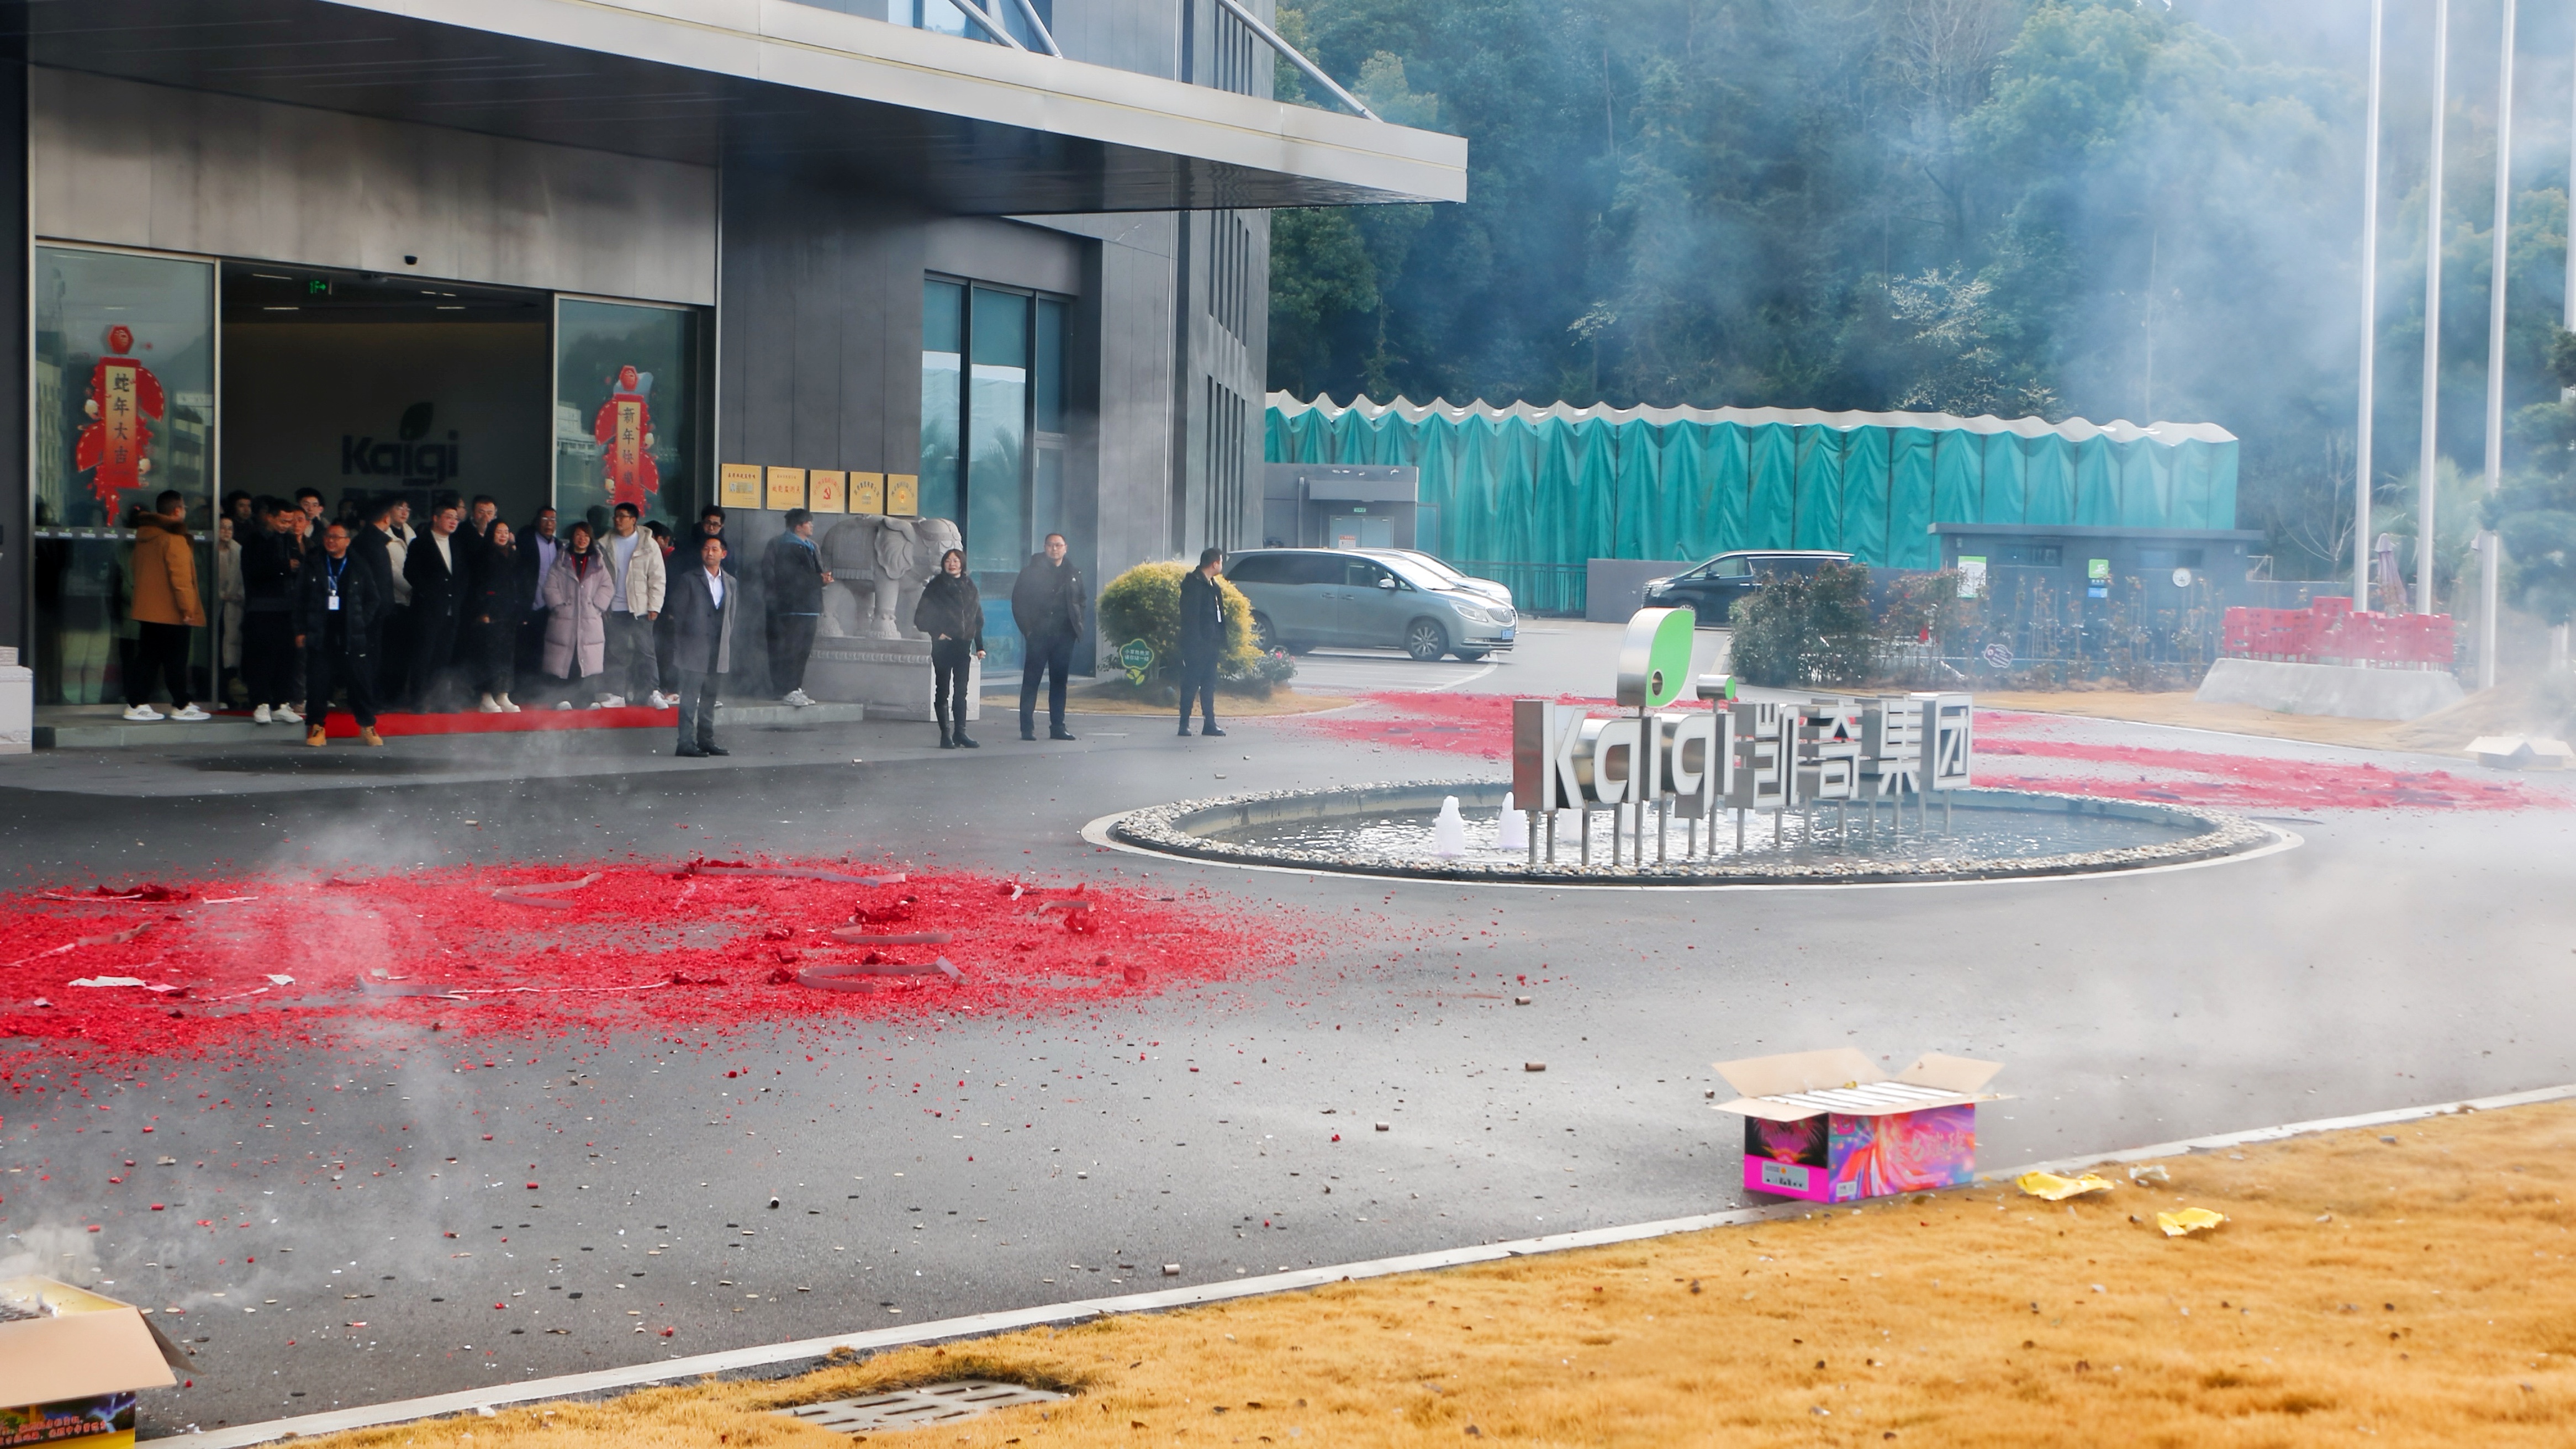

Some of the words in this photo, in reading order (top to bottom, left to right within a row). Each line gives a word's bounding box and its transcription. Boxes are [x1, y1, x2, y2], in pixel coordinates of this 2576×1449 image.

[113, 372, 130, 464] 蛇年大吉
[1726, 692, 1973, 809] 凯奇集团
